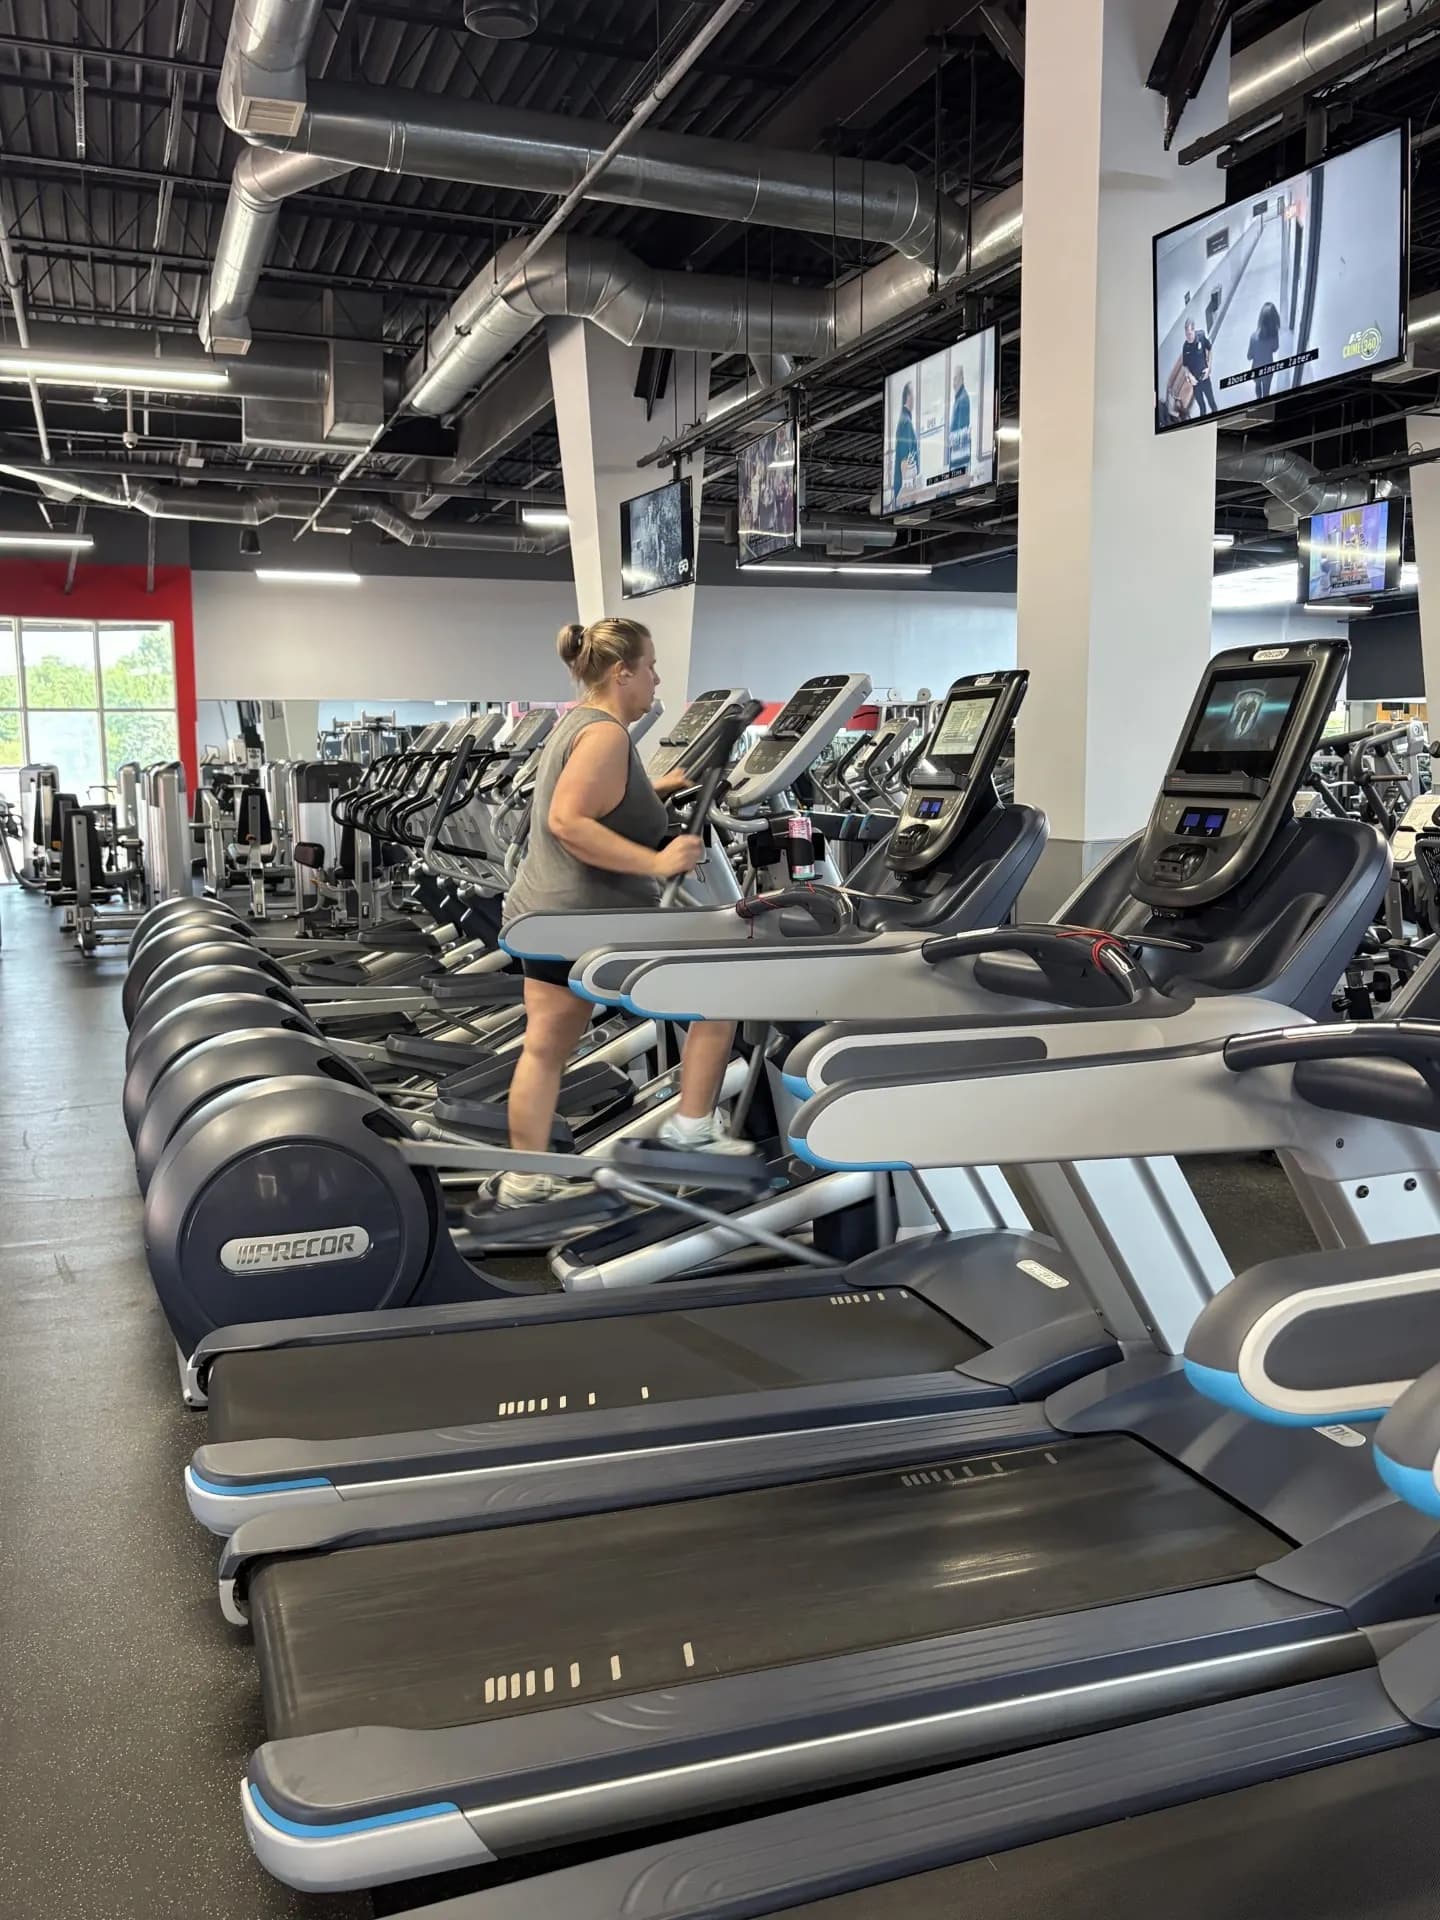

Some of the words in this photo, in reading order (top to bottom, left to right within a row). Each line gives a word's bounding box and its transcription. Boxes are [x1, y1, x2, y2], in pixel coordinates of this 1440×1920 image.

[1227, 373, 1247, 386] About
[1259, 362, 1284, 377] minute
[253, 1233, 355, 1264] PRECOR
